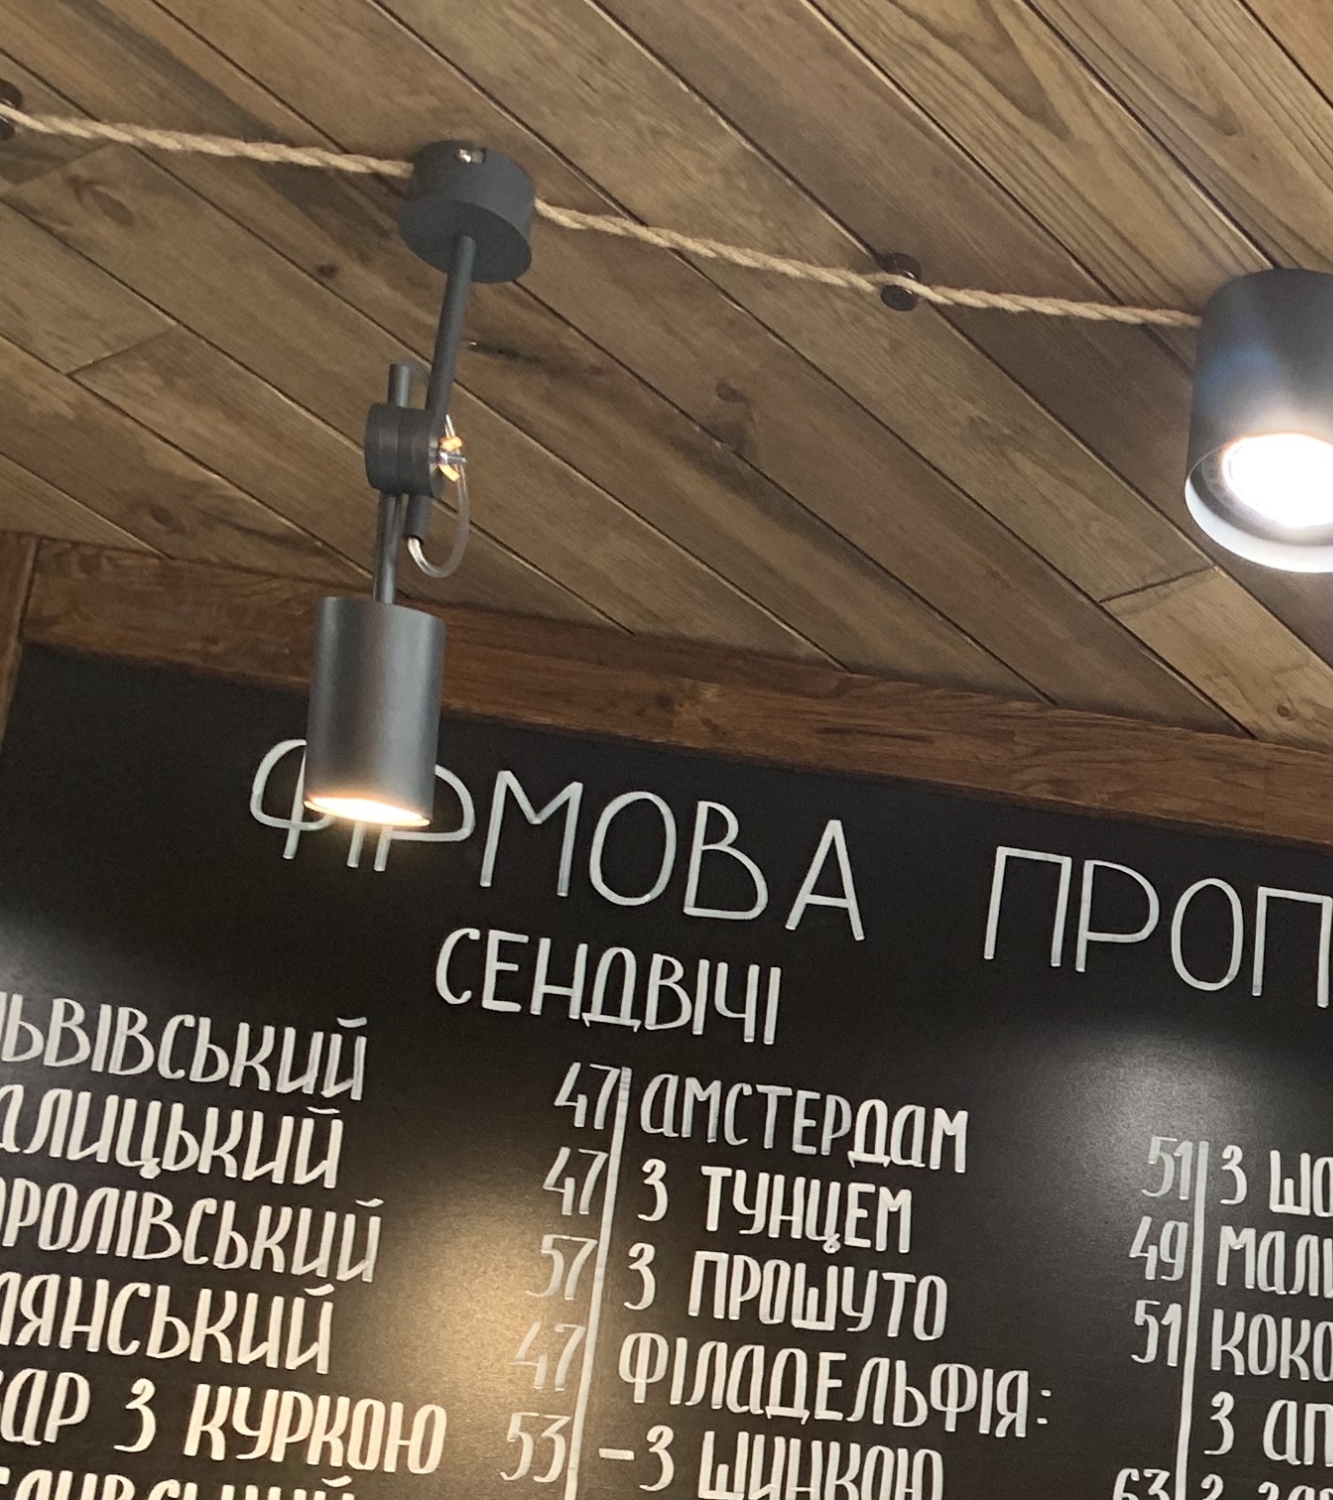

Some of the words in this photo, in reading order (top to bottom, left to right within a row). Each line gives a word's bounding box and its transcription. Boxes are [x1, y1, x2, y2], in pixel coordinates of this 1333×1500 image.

[436, 928, 781, 1045] СЕНДВІЧІ
[0, 991, 367, 1100] ЬВІВСЬКИЙ
[554, 1062, 620, 1129] 47
[542, 1147, 608, 1216] 47
[640, 1072, 969, 1174] АМСТЕРДАМ
[1141, 1135, 1194, 1200] 51
[0, 1175, 384, 1283] РОЛІВСЬКИЙ
[526, 1235, 599, 1300] 57
[700, 1165, 913, 1254] ТУНЦЕМ
[1128, 1215, 1189, 1282] 49
[514, 1321, 586, 1391] 47
[687, 1249, 949, 1341] ПРОШУТО
[1130, 1300, 1183, 1367] 51
[183, 1383, 448, 1475] КУРКОЮ
[500, 1411, 572, 1483] 53
[617, 1331, 1052, 1437] ФІЛАДЕЛЬФІЯ:
